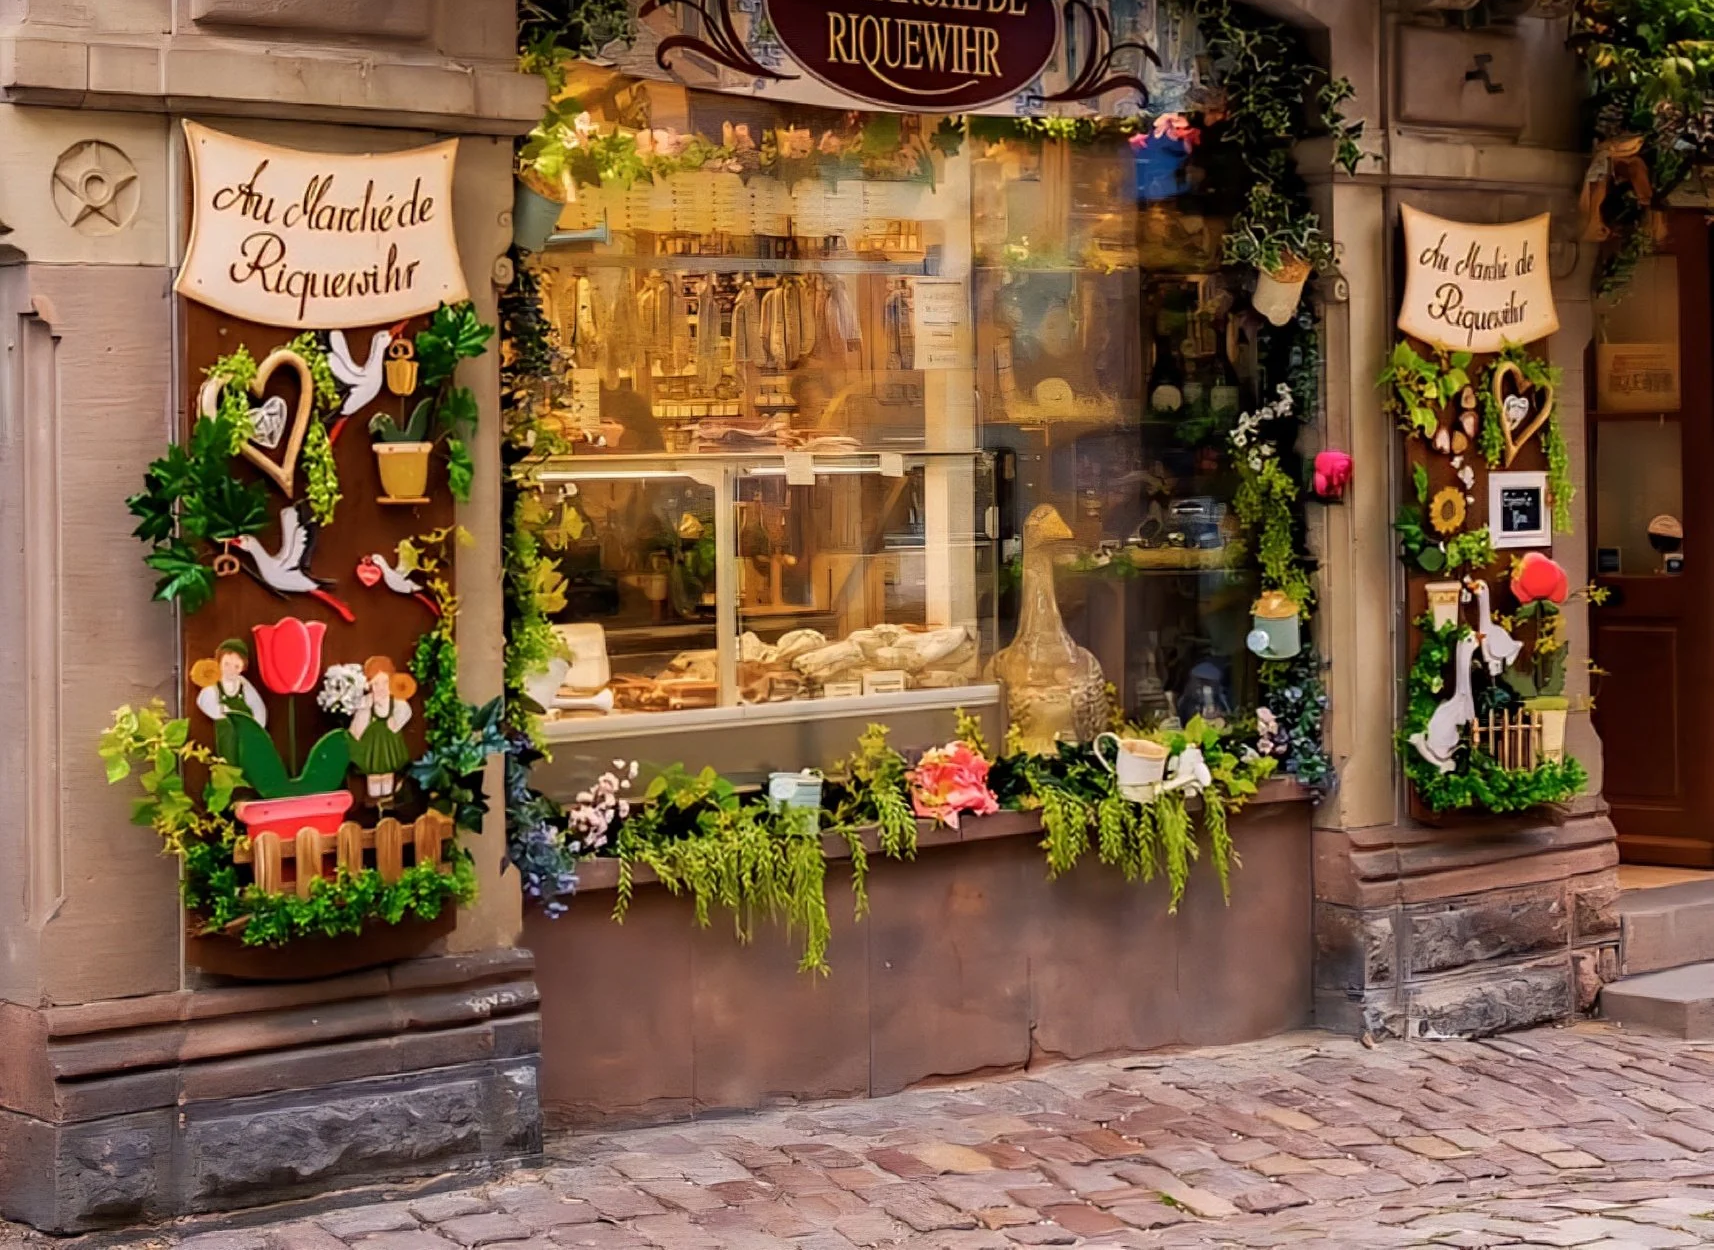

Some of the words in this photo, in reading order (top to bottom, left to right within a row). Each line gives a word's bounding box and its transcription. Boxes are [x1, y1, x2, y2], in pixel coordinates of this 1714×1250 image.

[827, 12, 1003, 95] RIQUEWIHR
[211, 159, 277, 224] Au
[282, 174, 395, 233] Marché
[397, 177, 436, 229] de
[229, 231, 421, 321] Riquewihr
[1420, 232, 1450, 273] Au
[1515, 239, 1535, 276] de
